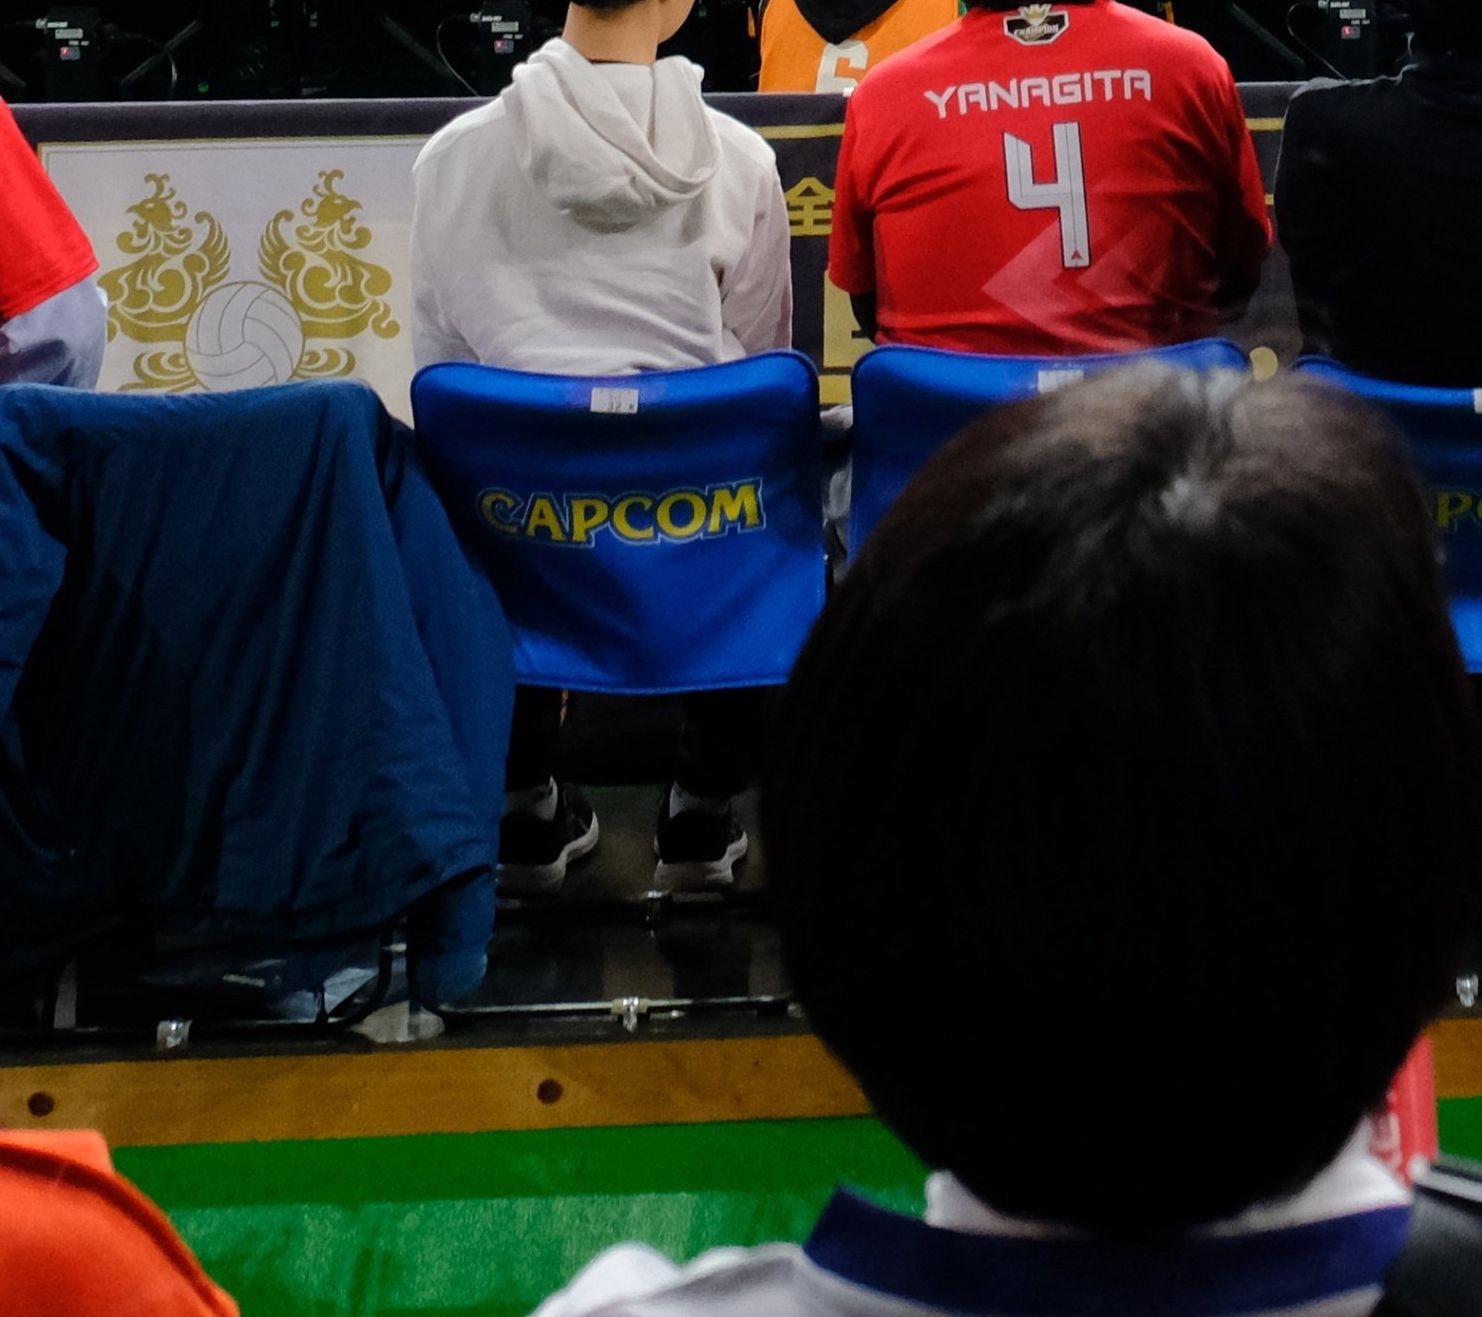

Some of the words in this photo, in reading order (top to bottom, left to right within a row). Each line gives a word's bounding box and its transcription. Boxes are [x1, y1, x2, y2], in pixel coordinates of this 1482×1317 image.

[1014, 22, 1059, 37] CHAMPION
[925, 70, 1152, 119] YANAGITA
[1004, 121, 1091, 269] 4
[477, 477, 766, 549] CAPCOM
